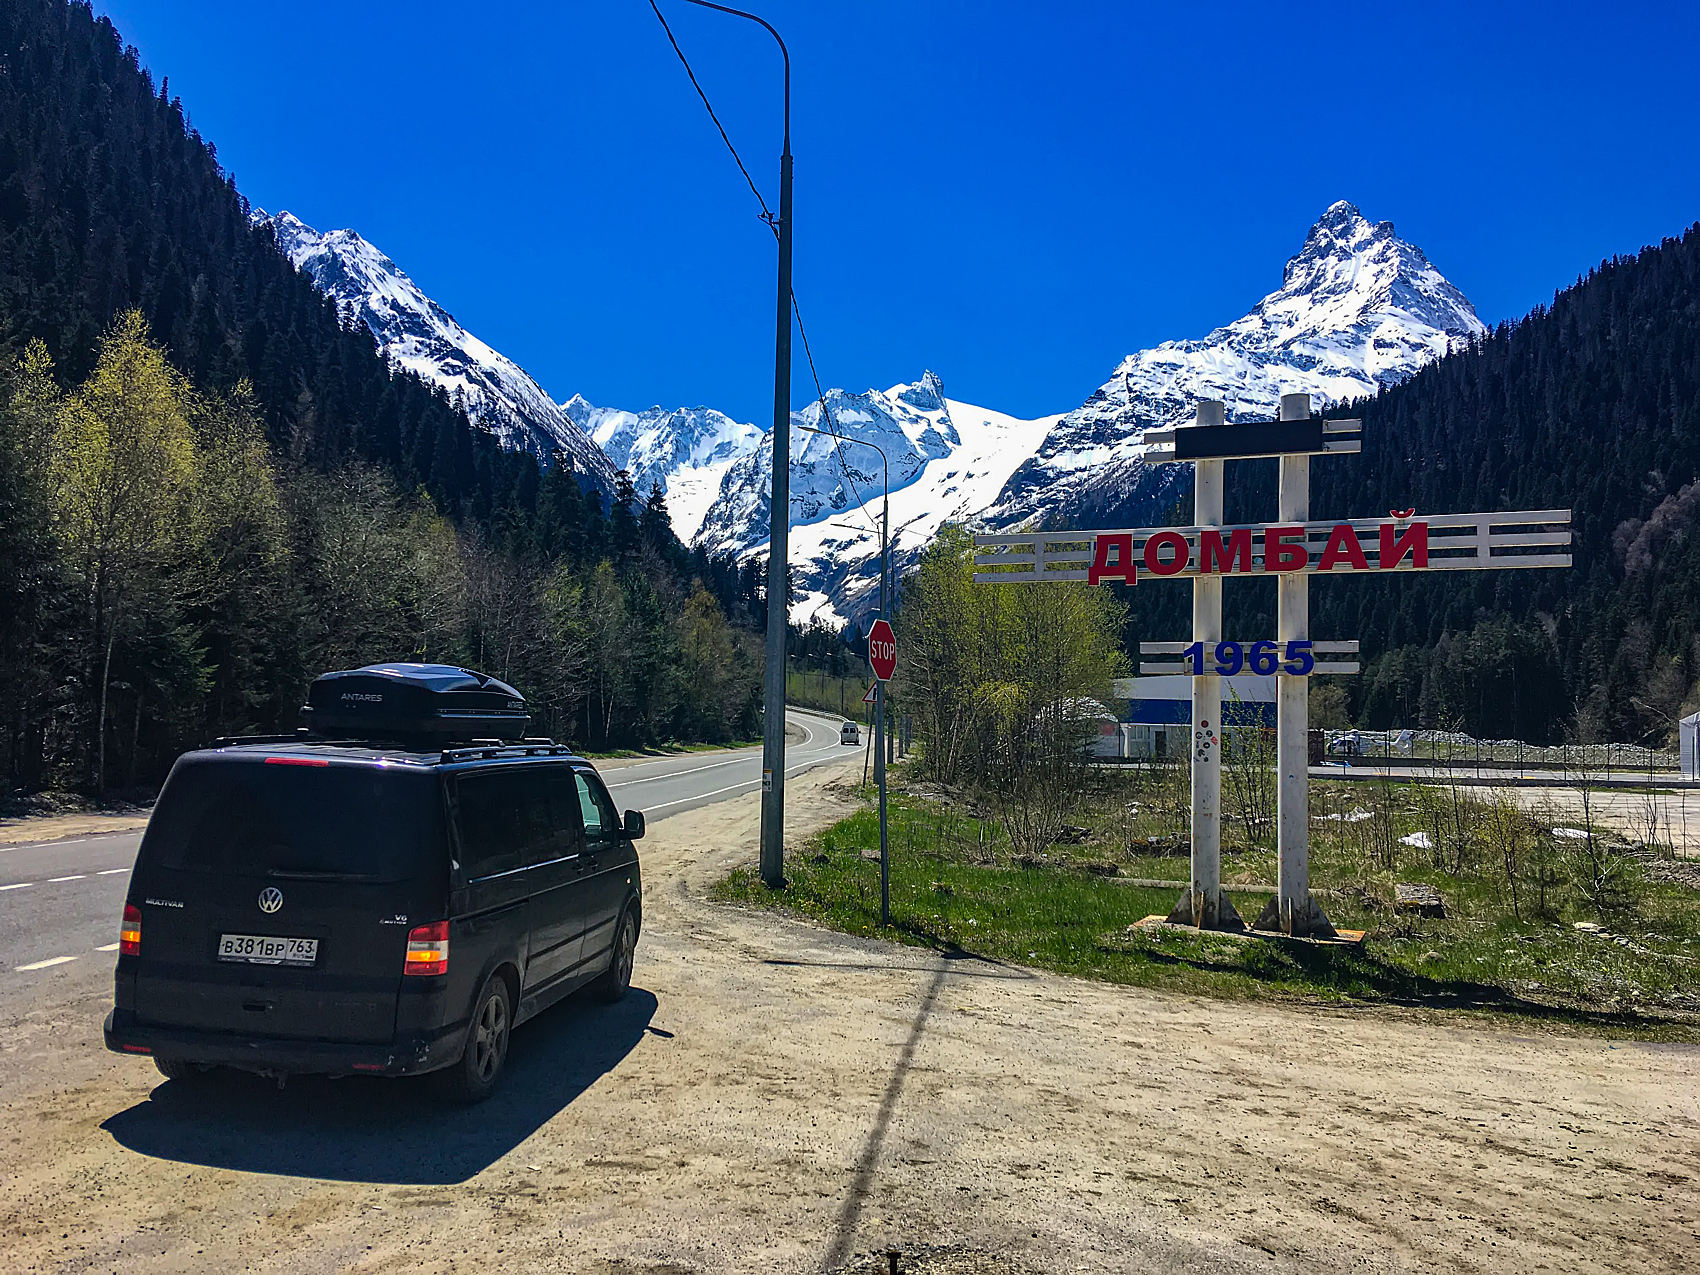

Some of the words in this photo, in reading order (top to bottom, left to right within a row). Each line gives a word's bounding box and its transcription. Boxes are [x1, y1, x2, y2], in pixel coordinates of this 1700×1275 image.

[1088, 507, 1428, 586] ДОМБАЙ
[871, 640, 895, 660] STOP
[1183, 640, 1314, 676] 1965
[341, 693, 383, 702] ANTARES
[145, 898, 184, 908] MULTIVAN
[289, 940, 314, 954] 763
